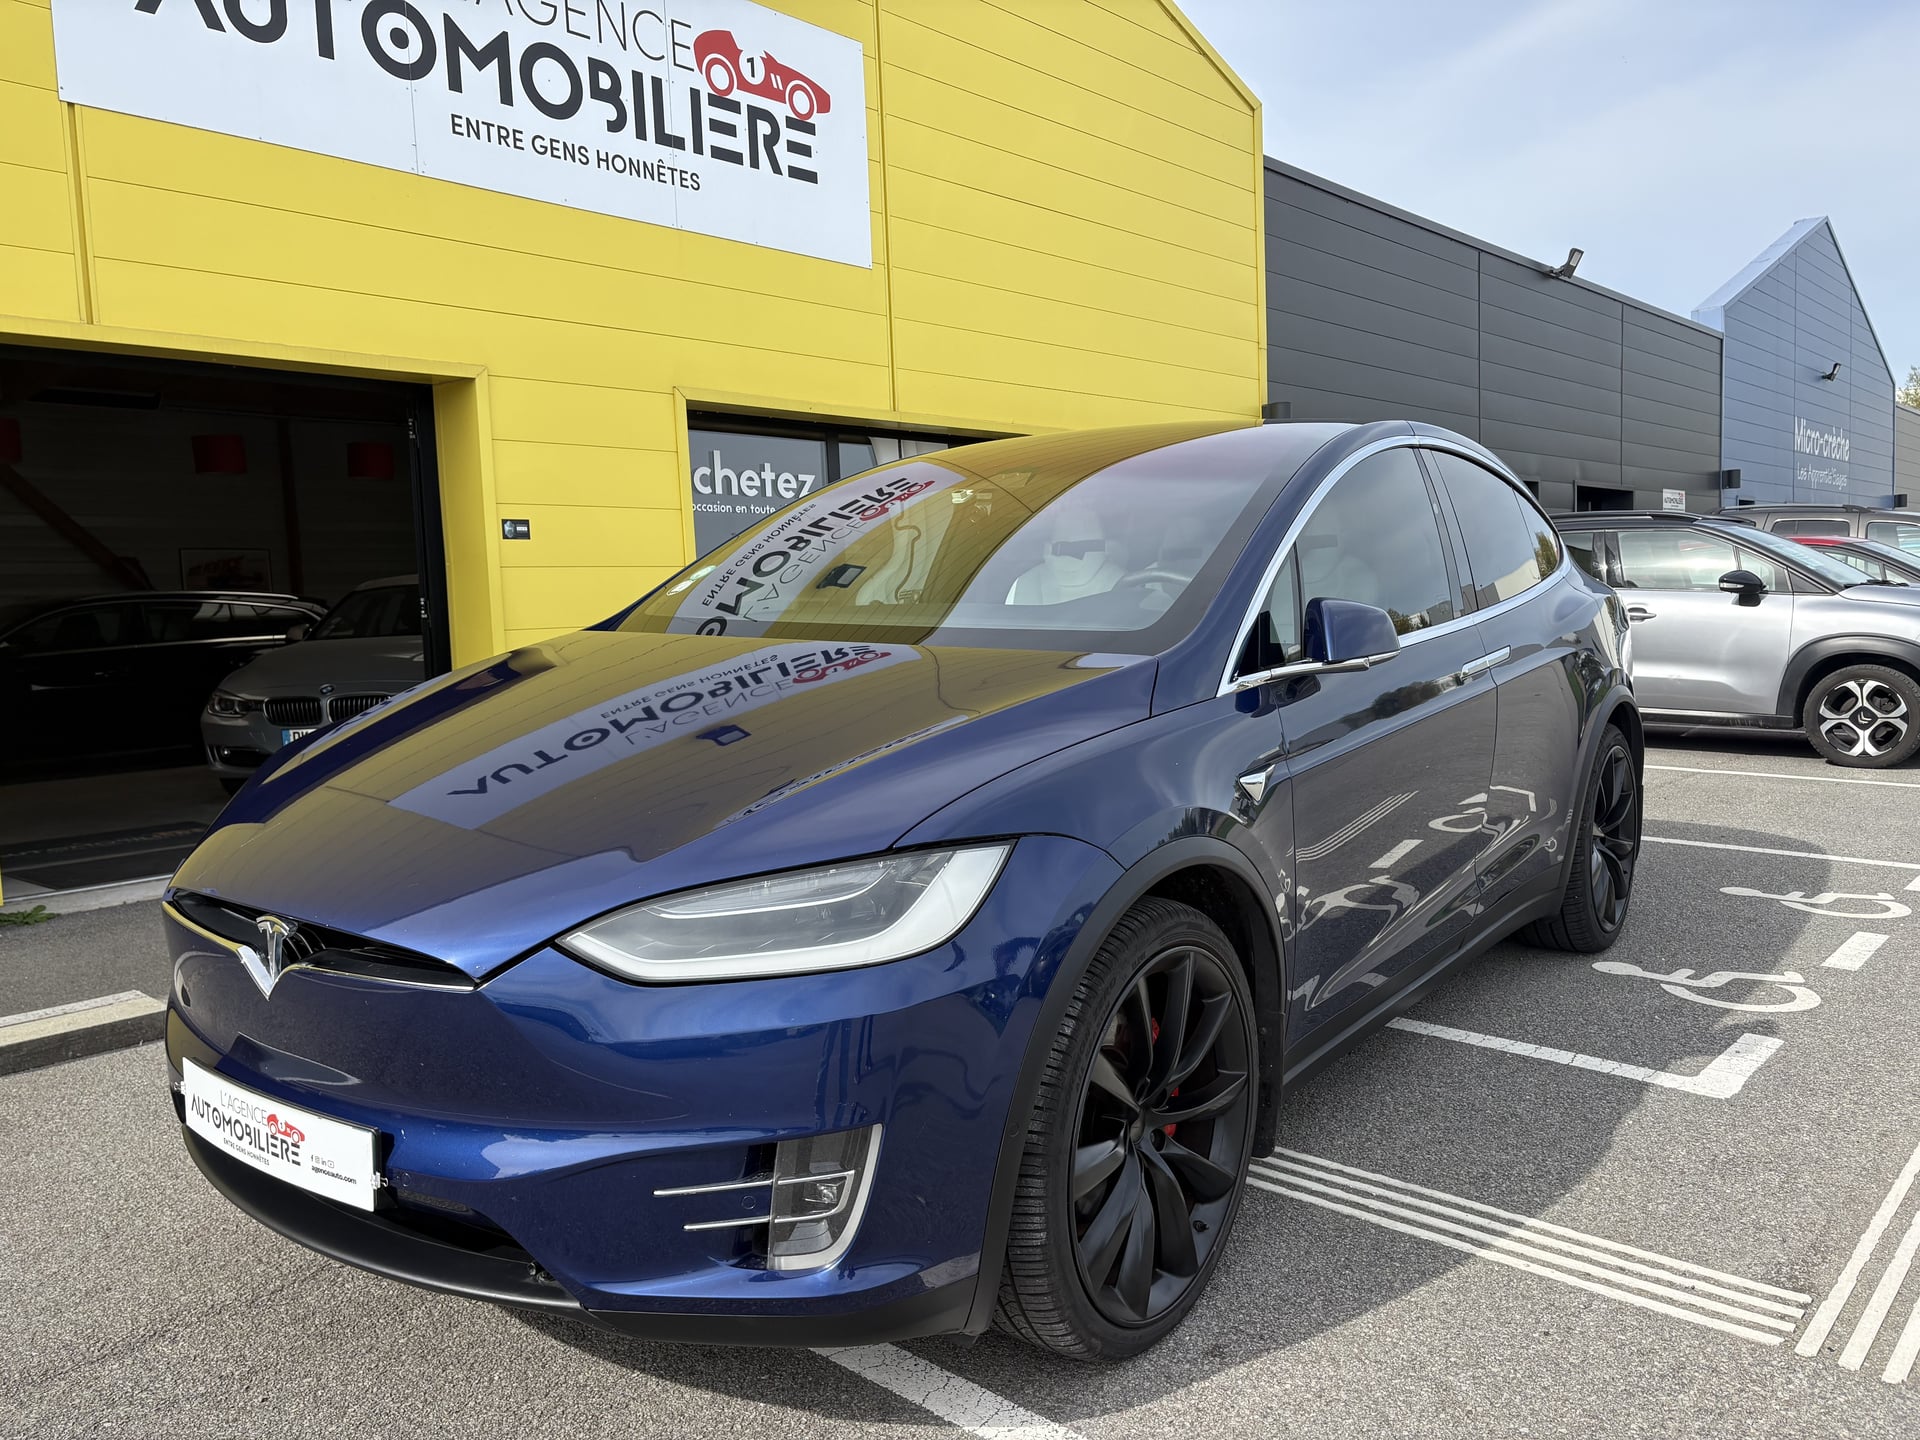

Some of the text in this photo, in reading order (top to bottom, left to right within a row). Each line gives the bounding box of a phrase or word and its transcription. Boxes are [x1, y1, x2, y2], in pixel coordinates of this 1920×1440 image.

[463, 0, 694, 72] GENCE
[746, 57, 755, 78] 1
[451, 113, 700, 191] ENTRE GENS HONNÊTES
[1795, 416, 1850, 462] Micro-crèche
[736, 505, 747, 513] en
[192, 1093, 301, 1166] AUTOMOBILIERE
[220, 1090, 267, 1126] L'AGENCE
